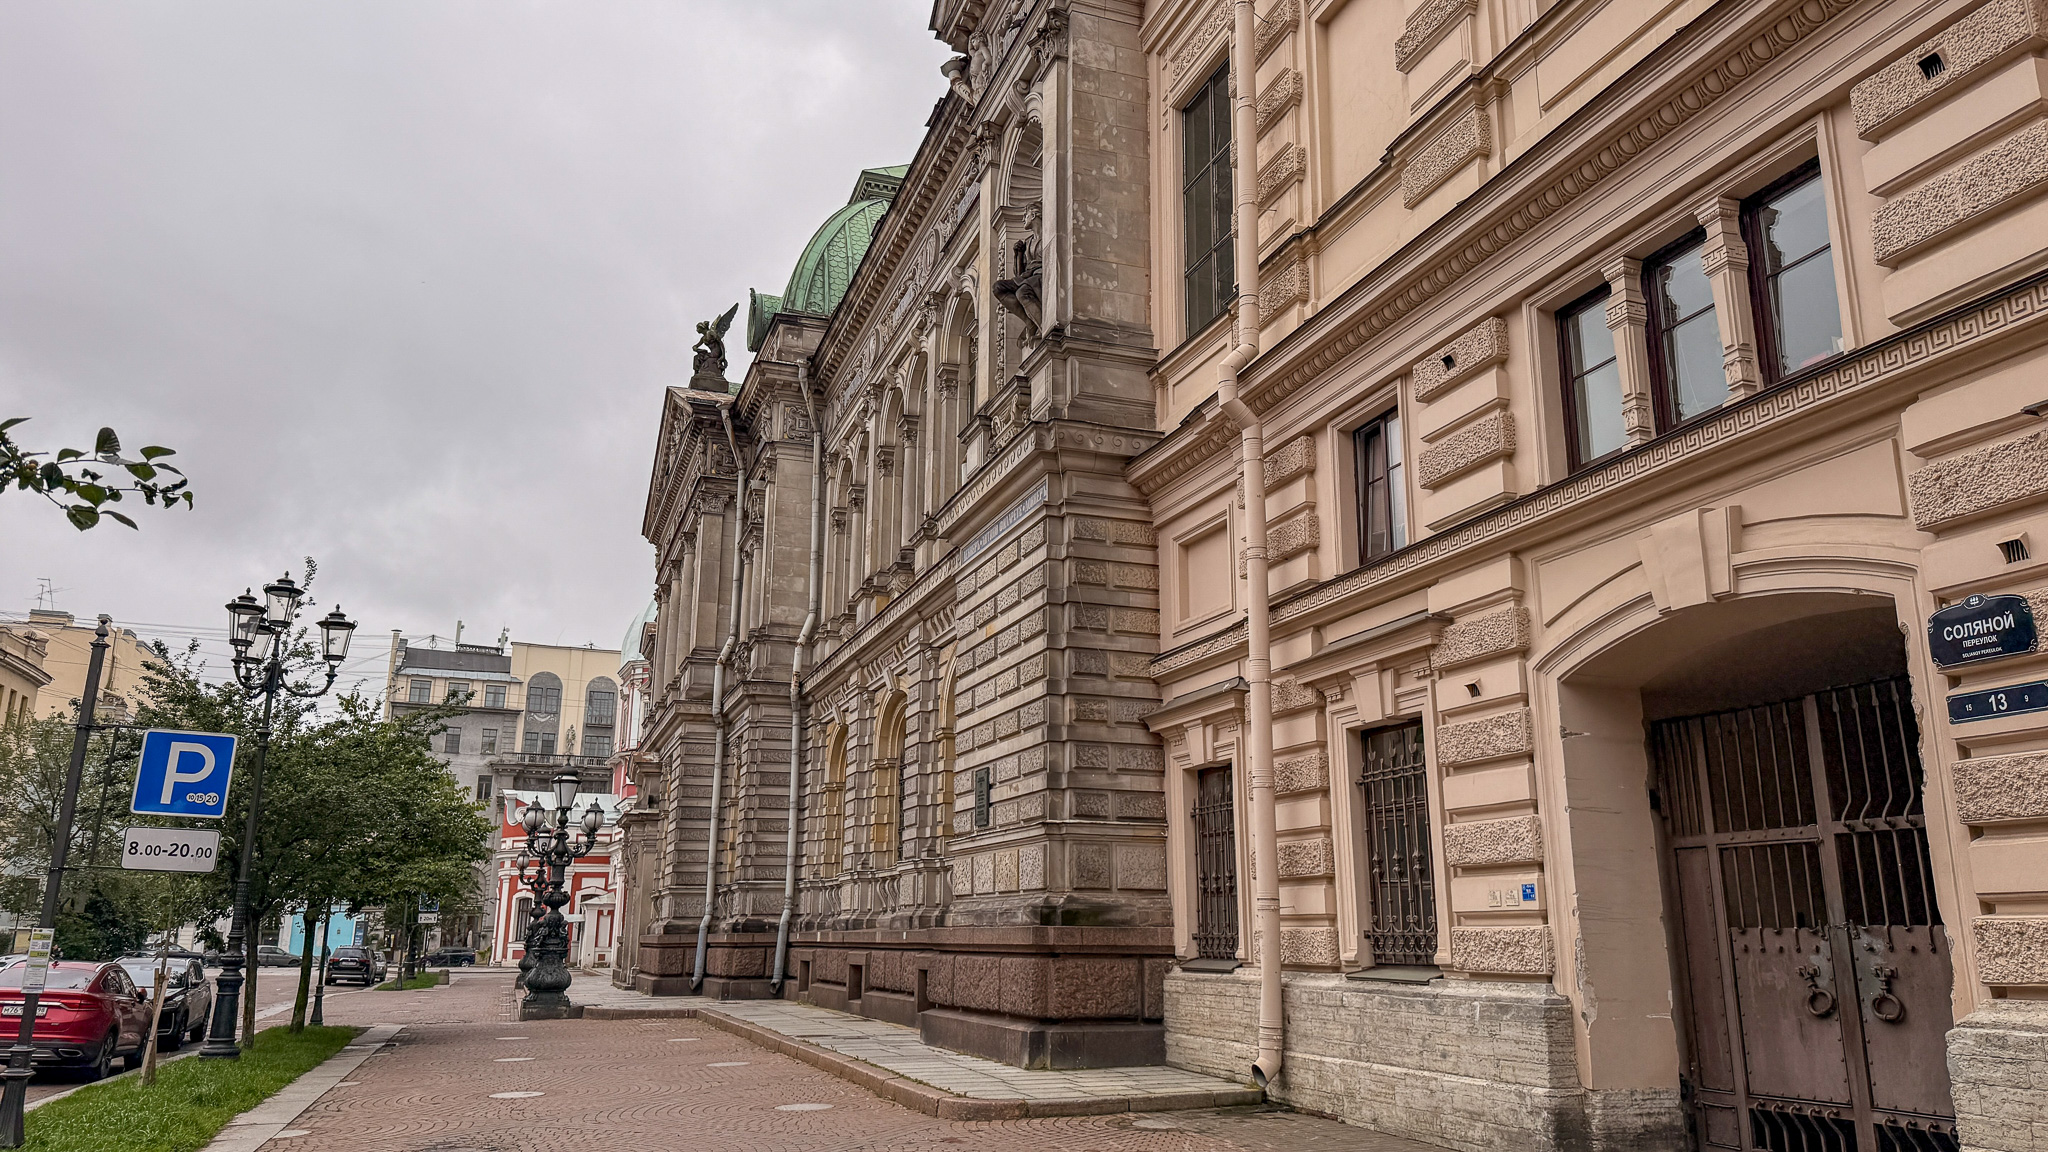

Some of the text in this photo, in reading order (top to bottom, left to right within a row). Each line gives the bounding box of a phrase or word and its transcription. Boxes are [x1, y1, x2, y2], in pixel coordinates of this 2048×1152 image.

[1943, 610, 2015, 641] СОЛЯНОЙ
[1962, 634, 1998, 648] ПЕРЕУЛОК
[1965, 693, 2029, 712] 15 13 9
[160, 741, 216, 805] P
[206, 794, 218, 803] 20
[128, 841, 213, 859] 8.00-20.00
